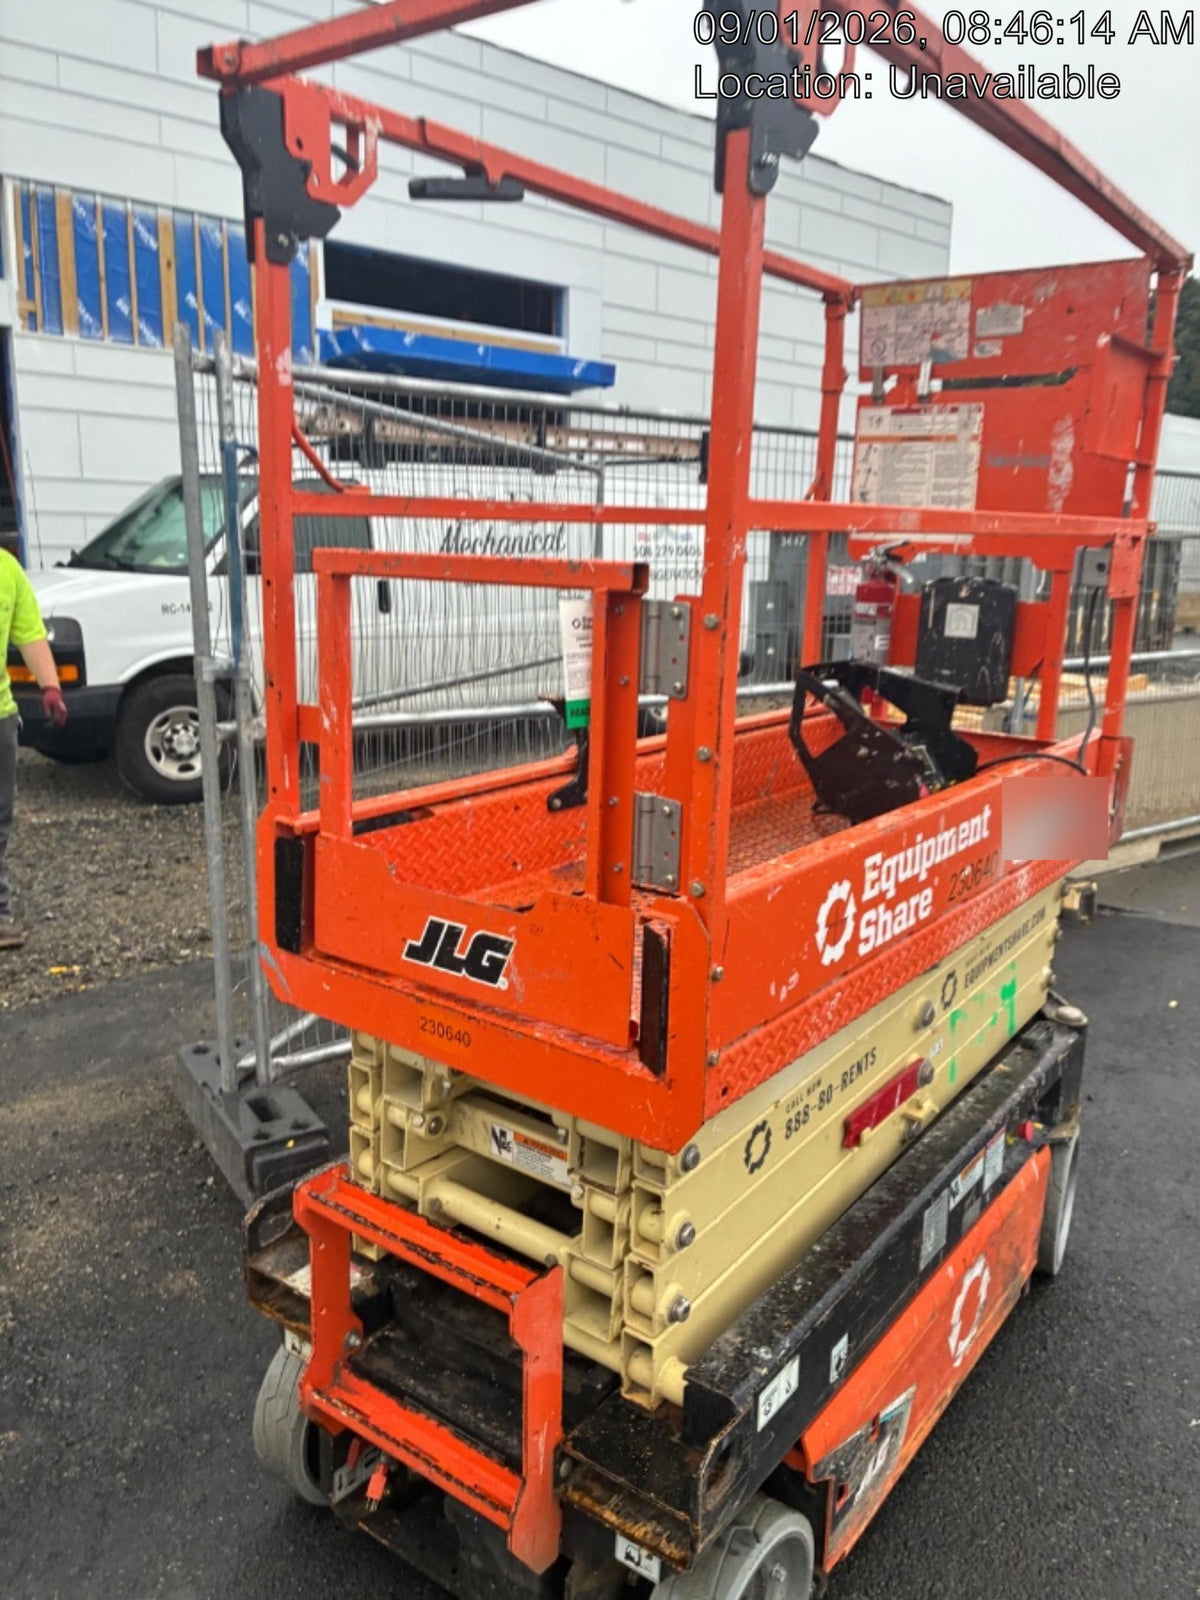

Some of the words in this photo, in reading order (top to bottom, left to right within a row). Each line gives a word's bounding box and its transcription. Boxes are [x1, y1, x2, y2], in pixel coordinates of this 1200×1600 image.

[439, 522, 567, 555] Mechanical
[861, 803, 992, 902] Equipment
[402, 914, 516, 990] JLG
[857, 886, 933, 957] Share
[420, 1016, 472, 1047] 230640
[784, 1046, 877, 1140] 888-80-RENTS
